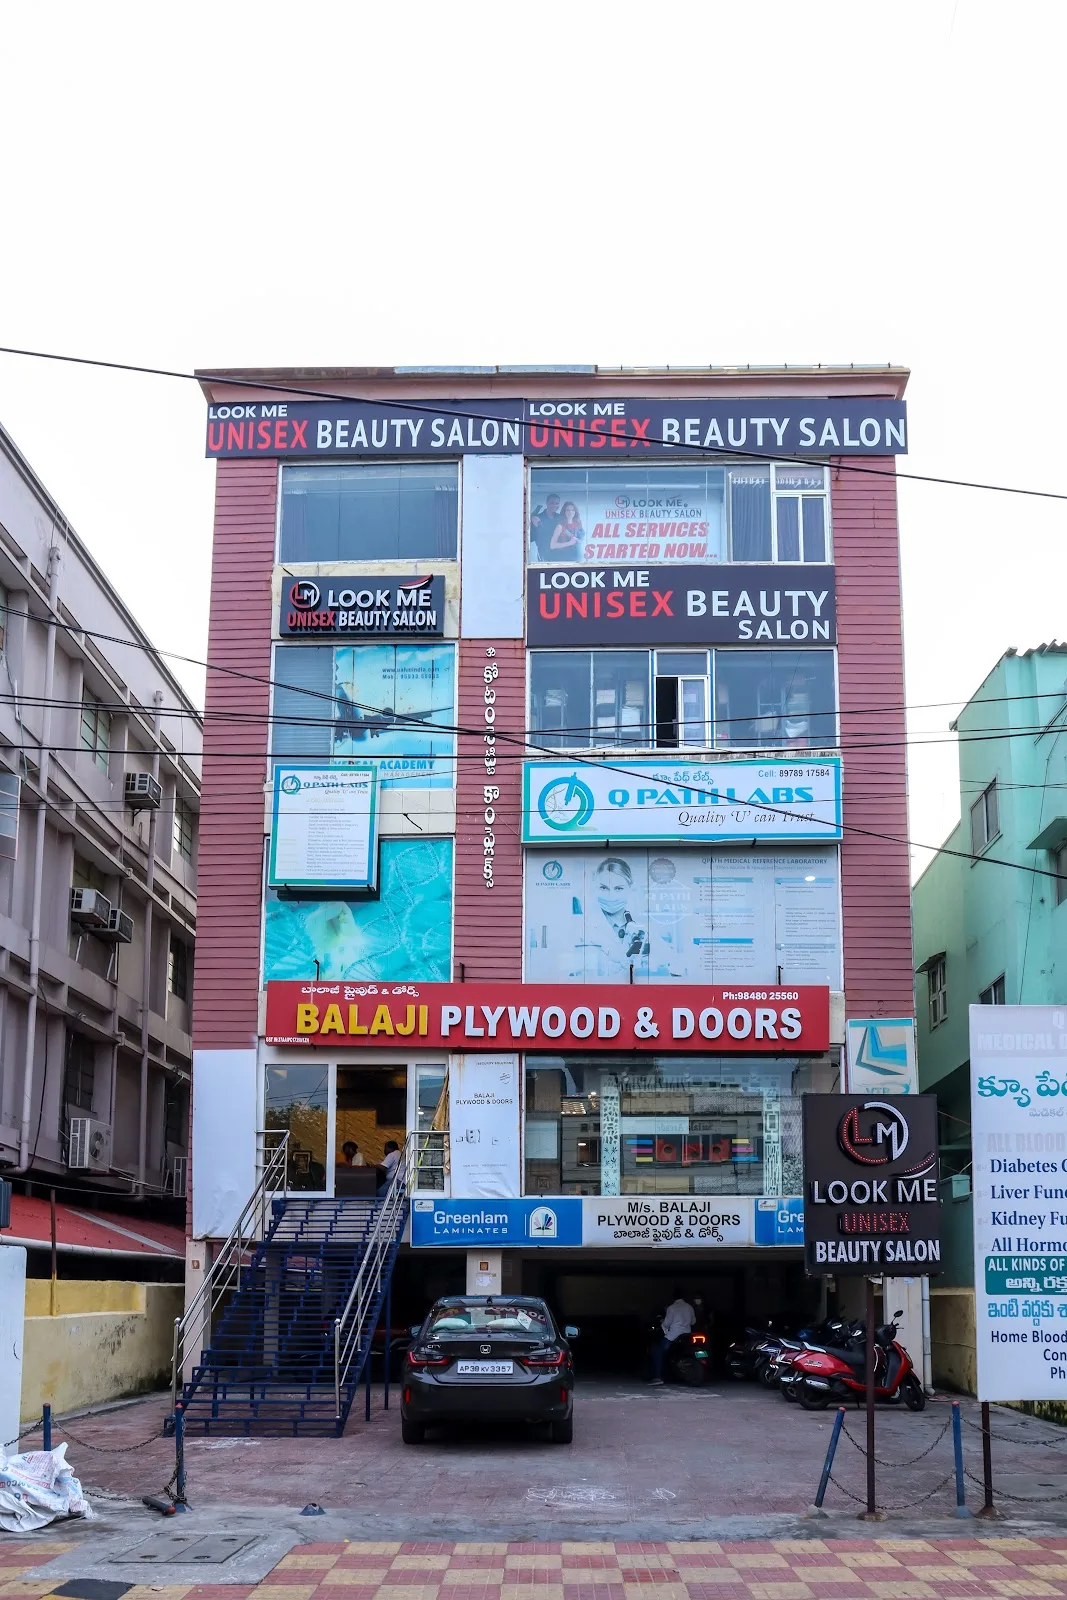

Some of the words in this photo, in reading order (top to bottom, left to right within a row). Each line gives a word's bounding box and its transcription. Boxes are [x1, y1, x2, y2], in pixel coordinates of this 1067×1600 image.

[208, 405, 256, 419] LOOK
[261, 404, 288, 417] ME
[529, 403, 587, 416] LOOK
[592, 403, 625, 415] ME
[208, 420, 309, 450] UNISEX
[316, 419, 424, 449] BEAUTY
[430, 418, 520, 447] SALON
[529, 418, 651, 448] UNISEX
[662, 417, 790, 448] BEAUTY
[799, 417, 905, 447] SALON
[605, 510, 636, 518] UNISEX
[640, 509, 672, 518] BEAUTY
[674, 509, 702, 518] SALON
[591, 523, 620, 538] ALL
[625, 522, 709, 537] SERVICES
[584, 543, 660, 559] STARTED
[539, 572, 606, 589] LOOK
[613, 571, 650, 587] ME
[327, 589, 390, 608] LOOK
[396, 589, 432, 607] ME
[539, 590, 675, 619] UNISEX
[687, 590, 829, 617] BEAUTY
[287, 611, 335, 628] UNISEX
[338, 611, 391, 627] BEAUTY
[392, 610, 437, 626] SALON
[738, 620, 830, 640] SALON
[380, 760, 435, 769] ACADEMY
[758, 770, 777, 778] Cell:
[779, 769, 803, 777] 89789
[806, 769, 830, 777] 17584
[608, 788, 630, 807] Q
[638, 788, 718, 804] PATH
[726, 787, 814, 804] LABS
[678, 811, 726, 826] Quality
[754, 814, 776, 823] can
[783, 811, 814, 823] Trust
[722, 991, 767, 1001] Ph:98480
[769, 991, 799, 1001] 25560
[296, 1003, 429, 1036] BALAJI
[440, 1005, 621, 1039] PLYWOOD
[634, 1007, 660, 1039] &
[672, 1007, 802, 1039] DOORS
[1052, 1011, 1065, 1030] Q
[977, 1032, 1056, 1051] MEDICAL
[977, 1075, 1031, 1107] క్యూ
[987, 1133, 1012, 1153] ALL
[1015, 1133, 1066, 1153] BLOOD
[990, 1158, 1058, 1173] Diabetes
[813, 1180, 888, 1204] LOOK
[990, 1185, 1030, 1199] Liver
[627, 1202, 654, 1213] M/s.
[659, 1201, 711, 1213] BALAJI
[434, 1210, 508, 1225] Greenlam
[597, 1215, 670, 1226] PLYWOOD
[674, 1215, 684, 1226] &
[688, 1215, 741, 1226] DOORS
[841, 1212, 910, 1233] UNISEX
[991, 1210, 1046, 1229] Kidney
[434, 1227, 508, 1235] LAMINATES
[613, 1227, 650, 1239] బాలాజీ
[684, 1230, 694, 1239] &
[816, 1241, 881, 1263] BEAUTY
[886, 1239, 941, 1262] SALON
[991, 1237, 1012, 1252] All
[987, 1258, 1008, 1271] ALL
[1011, 1258, 1046, 1271] KINDS
[1049, 1258, 1065, 1271] OF
[991, 1330, 1028, 1343] Home
